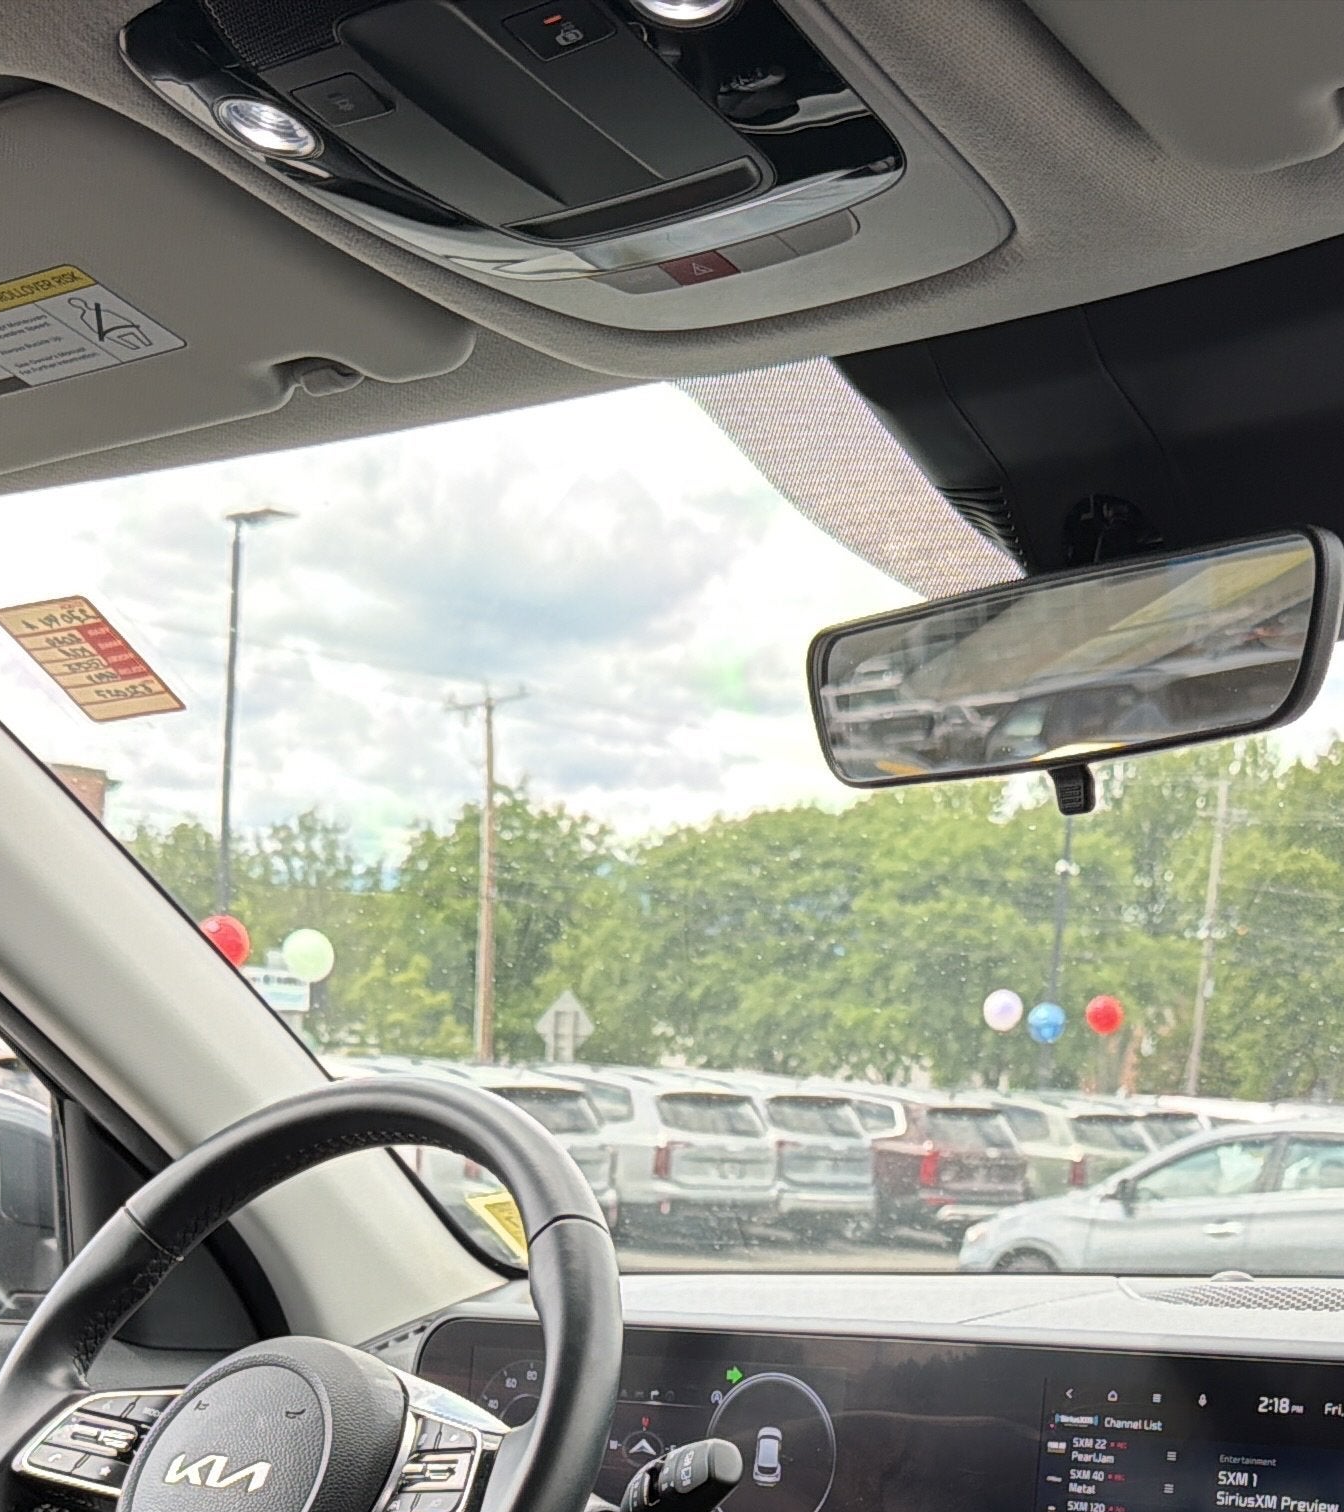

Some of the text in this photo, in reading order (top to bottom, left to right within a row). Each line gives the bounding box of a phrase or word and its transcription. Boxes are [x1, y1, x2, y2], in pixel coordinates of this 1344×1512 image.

[48, 270, 85, 286] RISK
[1257, 1396, 1290, 1414] 2:18
[1290, 1405, 1304, 1415] PM
[1104, 1417, 1142, 1430] Channel
[1144, 1418, 1163, 1432] List
[1072, 1437, 1094, 1449] SXM
[1094, 1439, 1107, 1450] 22
[1219, 1454, 1277, 1468] Entertainment
[1069, 1468, 1091, 1481] SXM
[1091, 1470, 1105, 1482] 40
[1217, 1470, 1258, 1488] SXM 1
[1068, 1482, 1097, 1496] Metal
[1066, 1500, 1088, 1512] SXM
[1215, 1490, 1278, 1510] SiriusXM
